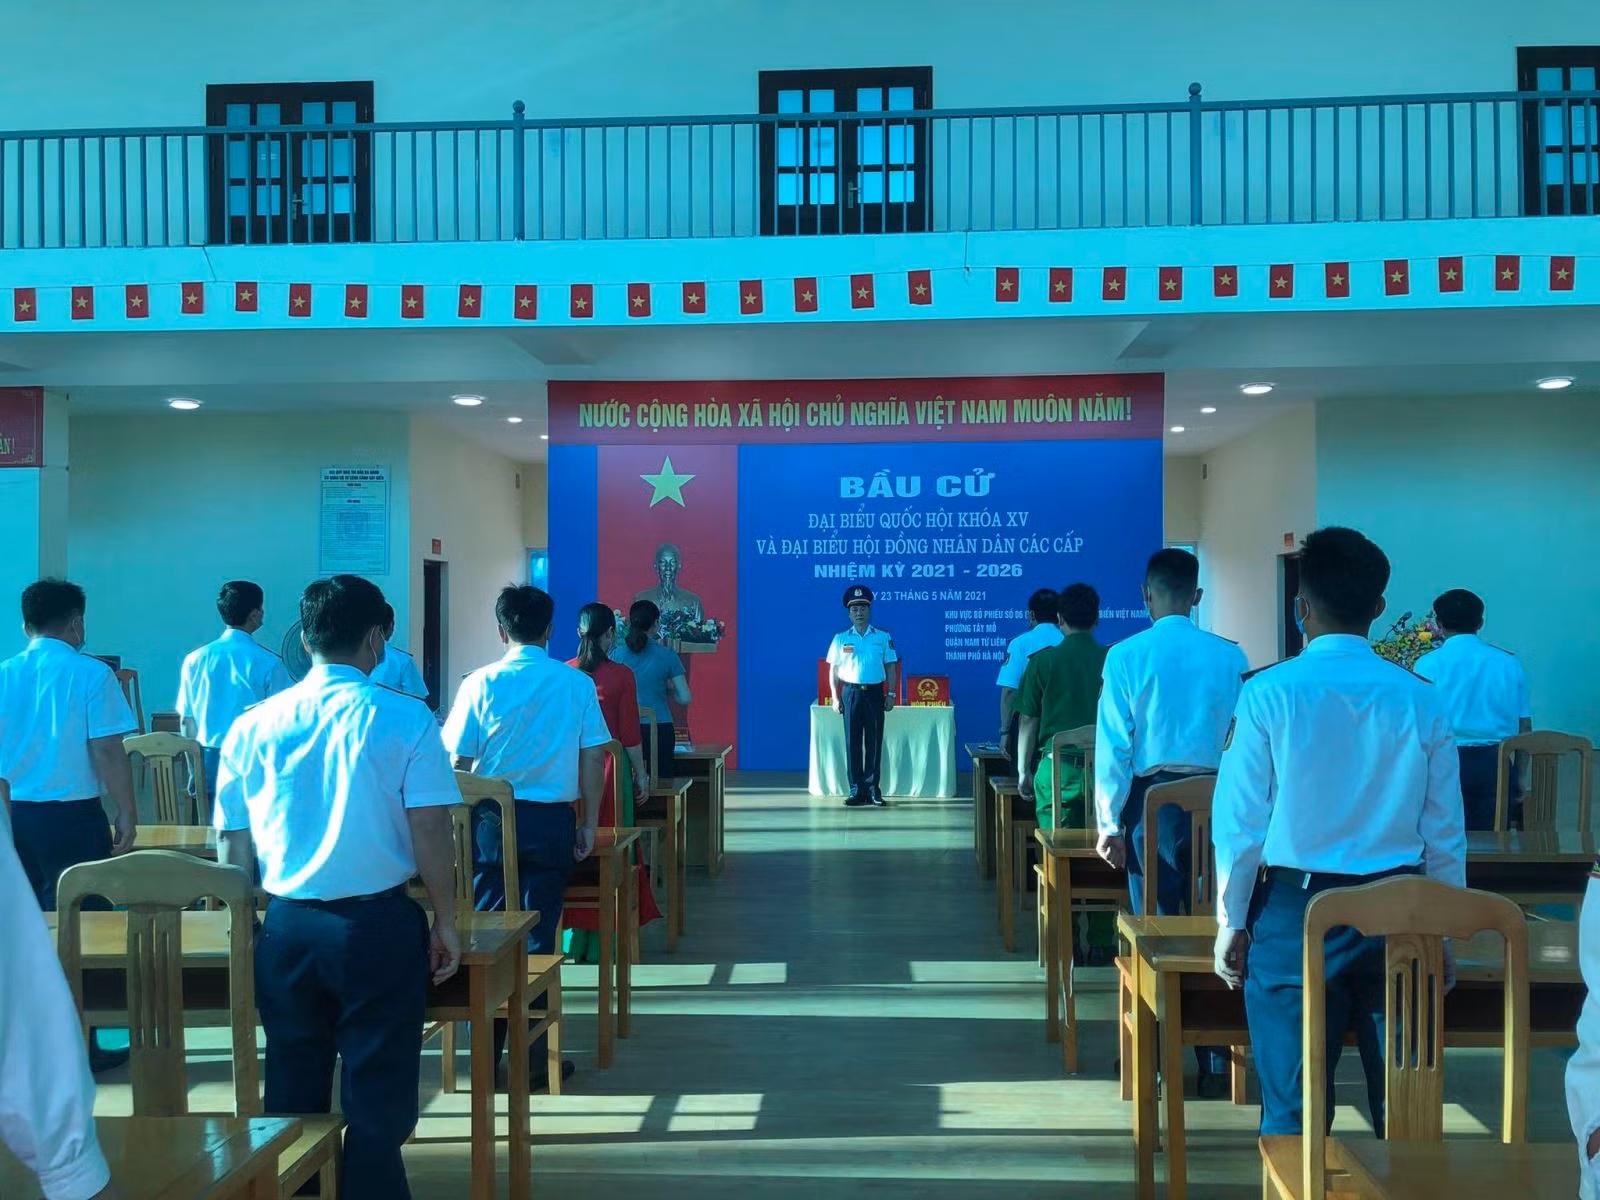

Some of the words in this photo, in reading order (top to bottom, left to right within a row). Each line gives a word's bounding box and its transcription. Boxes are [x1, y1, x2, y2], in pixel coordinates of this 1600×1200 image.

[579, 399, 631, 427] NƯỚC
[636, 398, 688, 432] CỘNG
[694, 397, 732, 427] HÒA
[738, 398, 763, 427] XÃ
[769, 397, 800, 432] HỘI
[806, 394, 844, 426] CHỦ
[850, 397, 909, 426] NGHĨA
[915, 396, 956, 430] VIỆT
[962, 399, 1006, 424] NAM
[1013, 393, 1072, 423] MUÔN
[1078, 392, 1132, 422] NĂM!
[839, 469, 921, 498] BẦU
[936, 467, 996, 498] CỬ
[808, 513, 836, 532] ĐẠI
[840, 503, 875, 529] BIỂU
[879, 505, 922, 529] QUỐC
[925, 507, 953, 532] HỘI
[957, 507, 1003, 528] KHÓA
[1006, 511, 1029, 527] XV
[756, 535, 777, 555] VÀ
[781, 539, 808, 559] ĐẠI
[813, 530, 848, 555] BIỂU
[852, 534, 880, 558] HỘI
[885, 531, 929, 555] ĐỒNG
[932, 533, 977, 554] NHÂN
[981, 533, 1016, 554] DÂN
[1019, 532, 1050, 554] CÁC
[1053, 529, 1084, 553] CẤP
[814, 562, 876, 581] NHIỆM
[881, 561, 906, 578] KỲ
[911, 564, 955, 578] 2021
[976, 563, 1023, 578] 2026
[880, 591, 892, 601] 23
[894, 589, 929, 601] THÁNG
[931, 591, 938, 601] 5
[940, 589, 962, 601] NĂM
[964, 591, 987, 601] 2021
[945, 610, 958, 619] KHU
[959, 609, 972, 621] VỰC
[984, 608, 1004, 619] PHIẾU
[1004, 608, 1014, 619] SỐ
[1115, 607, 1129, 621] VIỆT
[945, 623, 971, 633] PHƯỜNG
[973, 623, 985, 633] TÂY
[964, 638, 980, 647] NAM
[991, 636, 1007, 647] LIÊM
